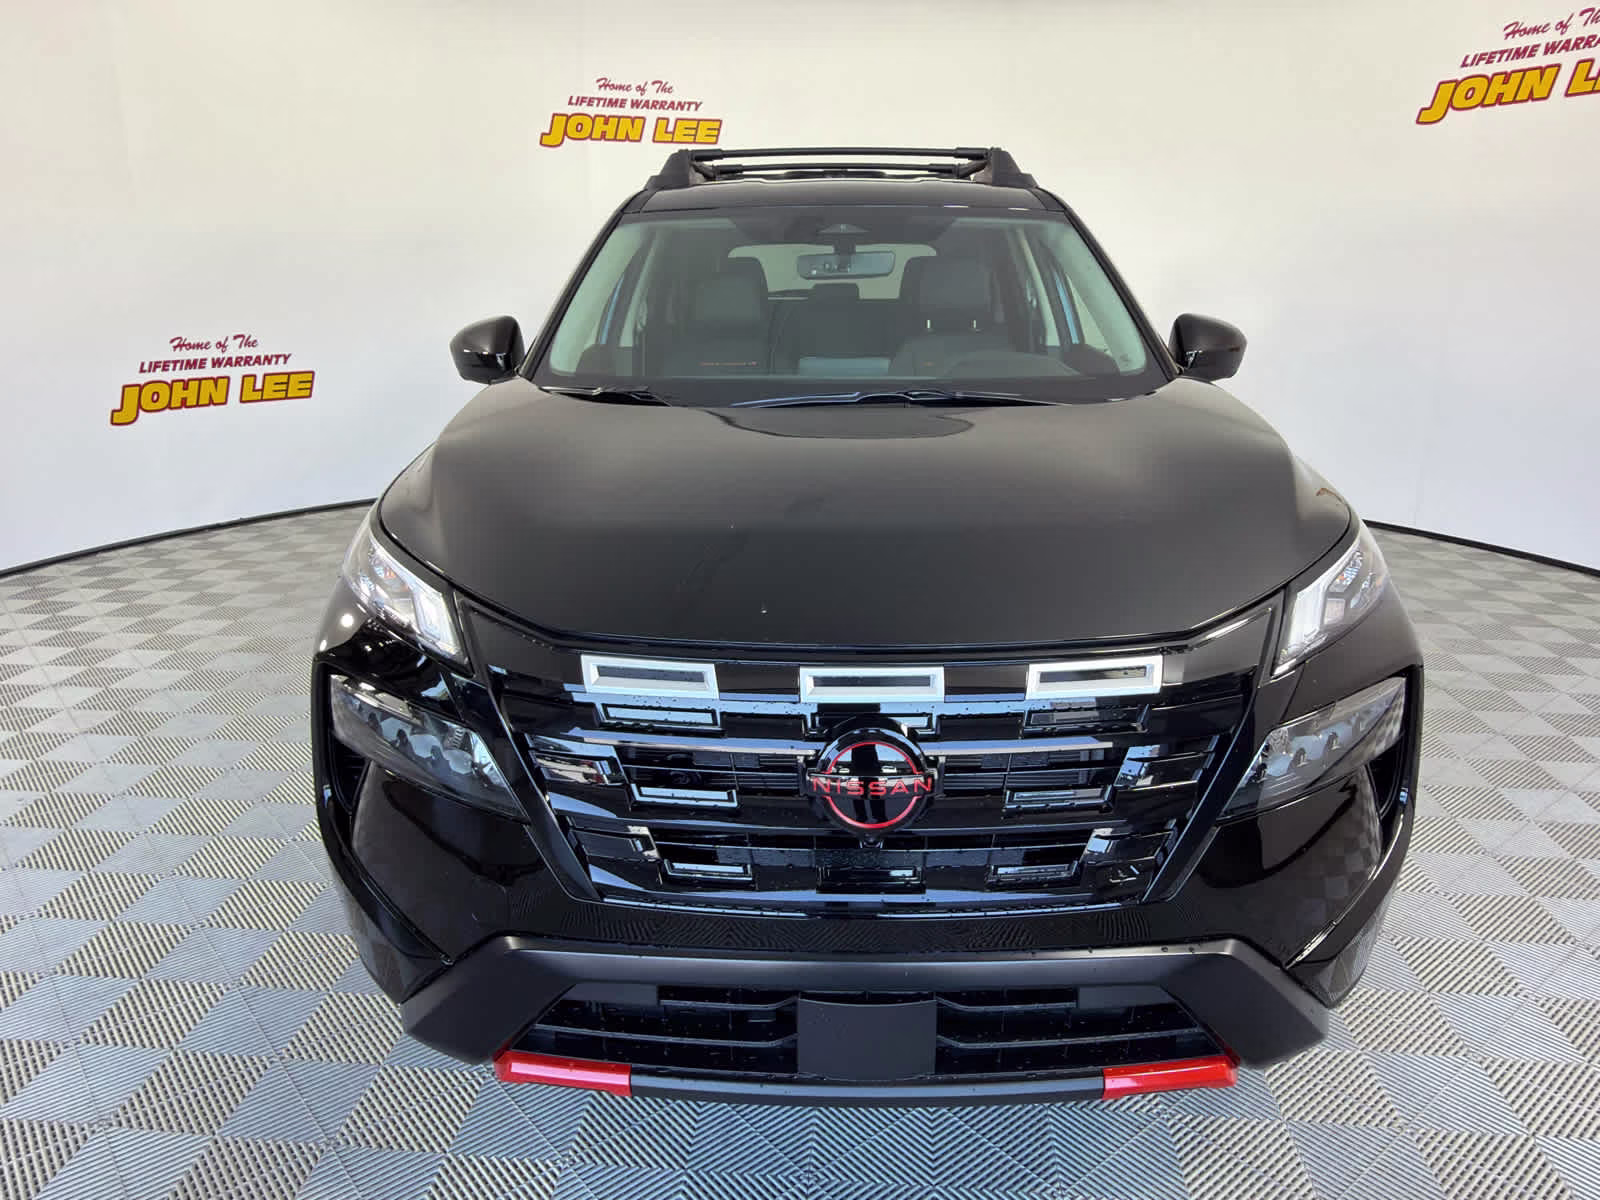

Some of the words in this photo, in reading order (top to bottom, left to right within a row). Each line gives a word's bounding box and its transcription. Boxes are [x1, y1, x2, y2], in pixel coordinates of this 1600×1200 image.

[1503, 21, 1550, 40] Home
[1555, 13, 1574, 35] of
[1460, 44, 1540, 68] LIFETIME
[596, 77, 632, 92] Home
[635, 81, 648, 96] of
[651, 80, 673, 94] The
[1416, 63, 1562, 125] JOHN
[567, 95, 627, 109] LIFETIME
[630, 99, 702, 111] WARRANTY
[539, 113, 646, 148] JOHN
[652, 117, 722, 145] LEE
[169, 336, 211, 352] Home
[215, 336, 229, 353] of
[232, 334, 258, 349] The
[139, 358, 208, 374] LIFETIME
[211, 353, 292, 369] WARRANTY
[110, 376, 230, 426] JOHN
[239, 370, 315, 403] LEE
[811, 777, 933, 796] NISSAN
